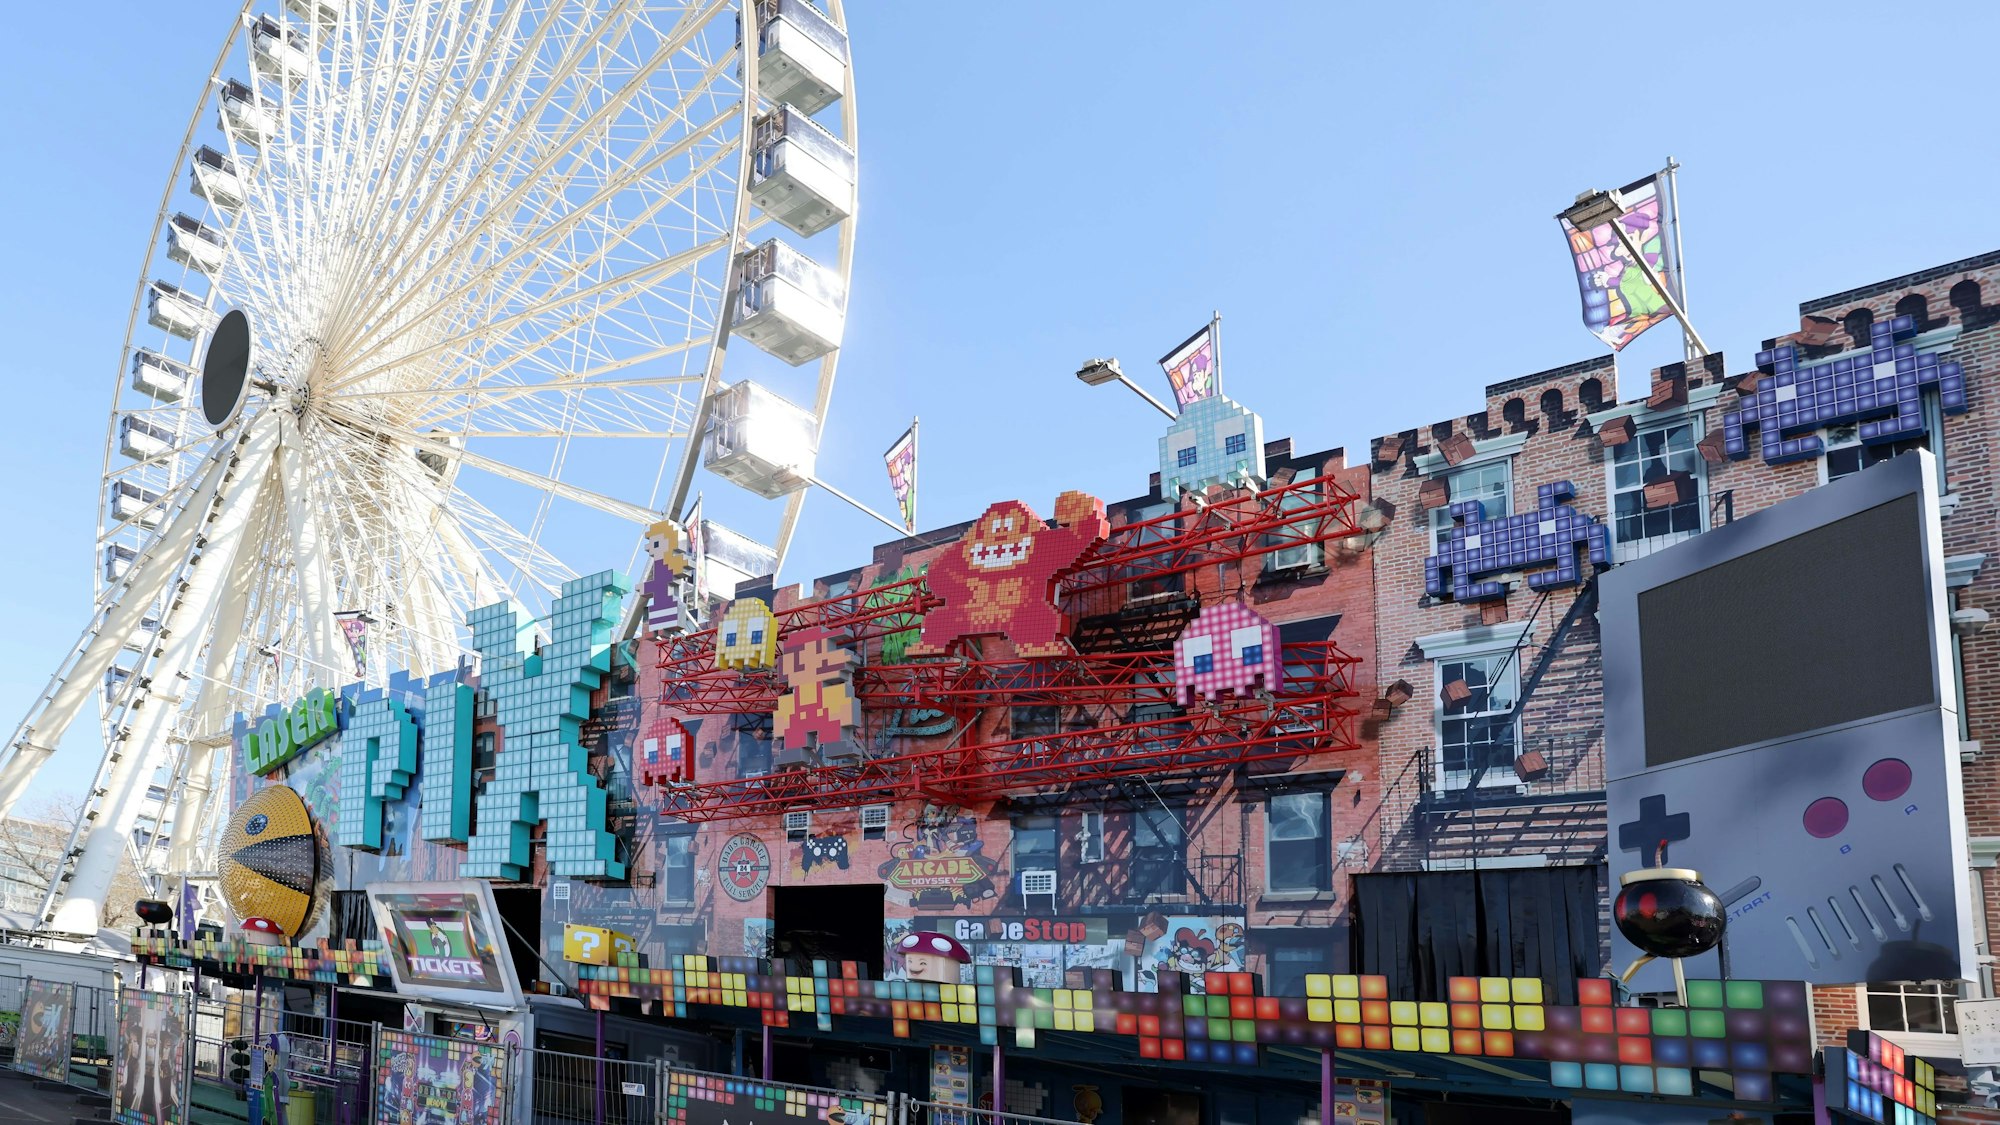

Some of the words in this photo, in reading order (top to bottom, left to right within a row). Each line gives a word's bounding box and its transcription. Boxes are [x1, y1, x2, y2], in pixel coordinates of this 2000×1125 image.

[242, 687, 337, 776] LASER
[339, 570, 625, 879] PIX
[1904, 804, 1918, 815] A
[740, 837, 767, 861] GARAGE
[1840, 844, 1851, 854] B
[900, 859, 972, 877] ARCADE
[723, 877, 736, 896] FULL
[738, 877, 764, 897] SERVICE
[911, 877, 958, 885] ODYSSEY
[954, 918, 1086, 943] GaeStop
[407, 957, 483, 976] TICKETS
